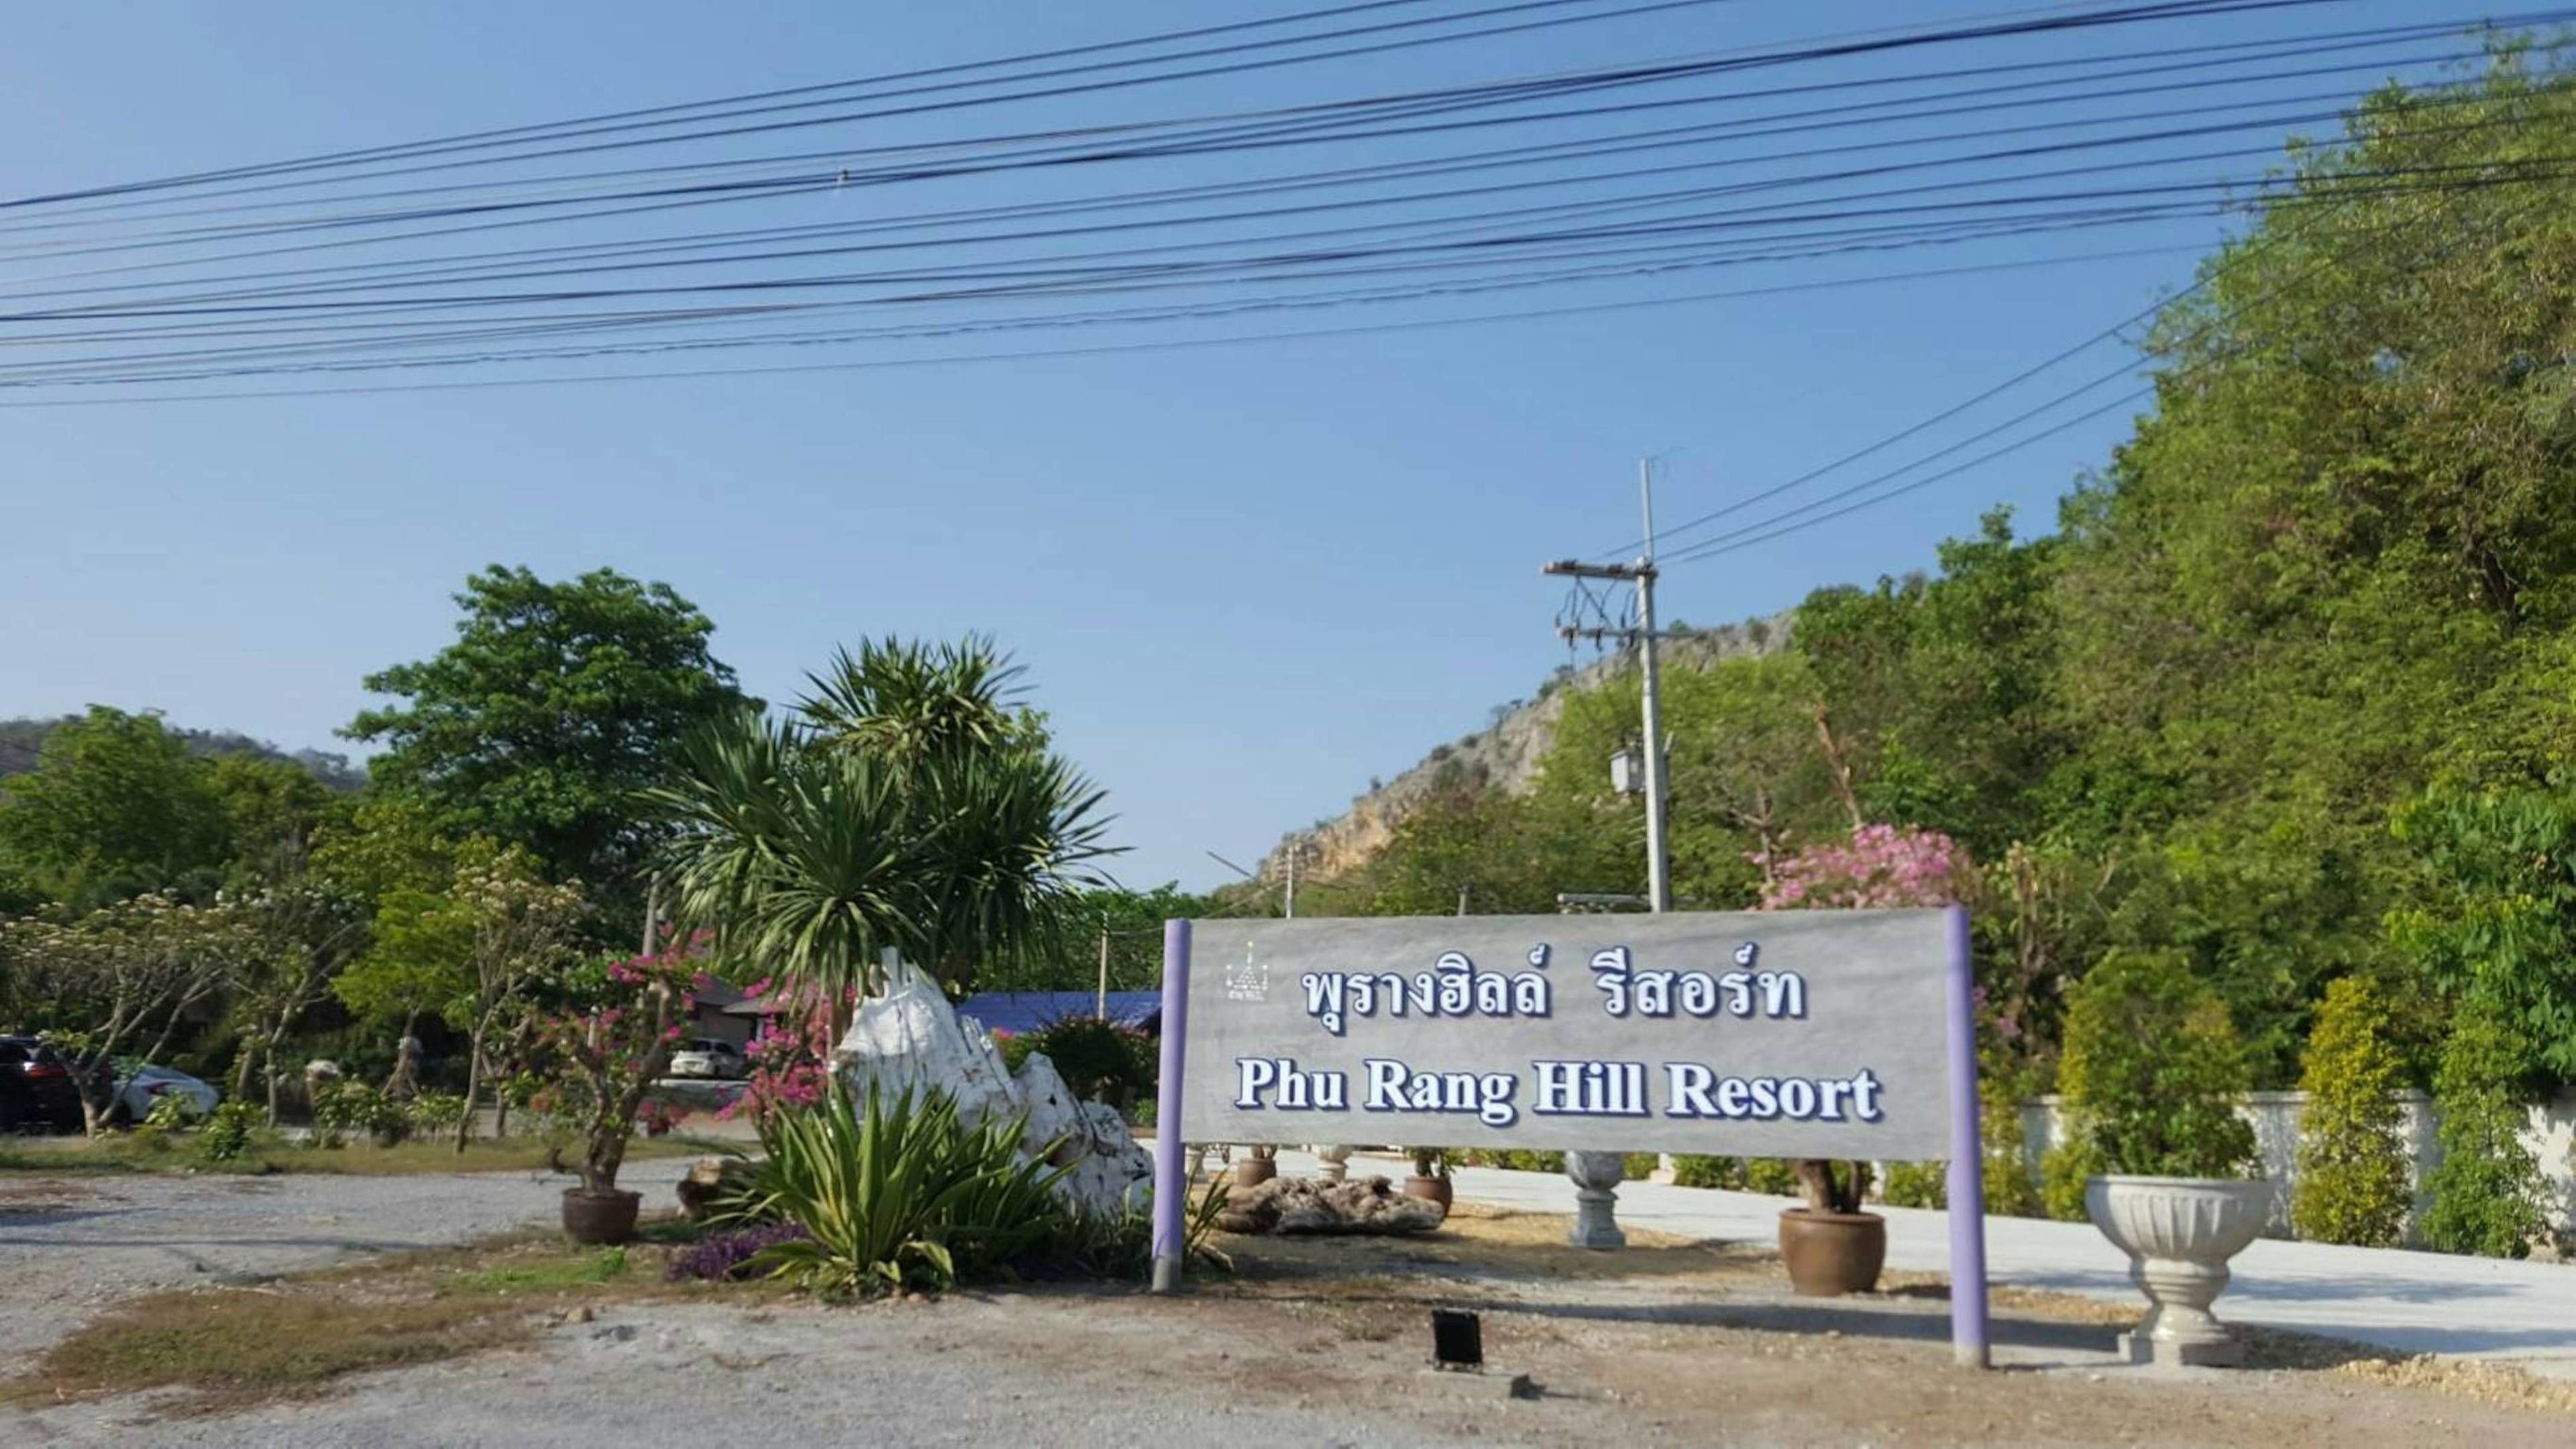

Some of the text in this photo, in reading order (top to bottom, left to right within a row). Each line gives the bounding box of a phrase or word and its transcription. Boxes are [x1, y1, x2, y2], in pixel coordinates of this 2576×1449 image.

[1302, 943, 1806, 1035] พุรางฮิลล์ รีสอร์ท
[1235, 1057, 1881, 1126] Phu Rang Hill Resort
